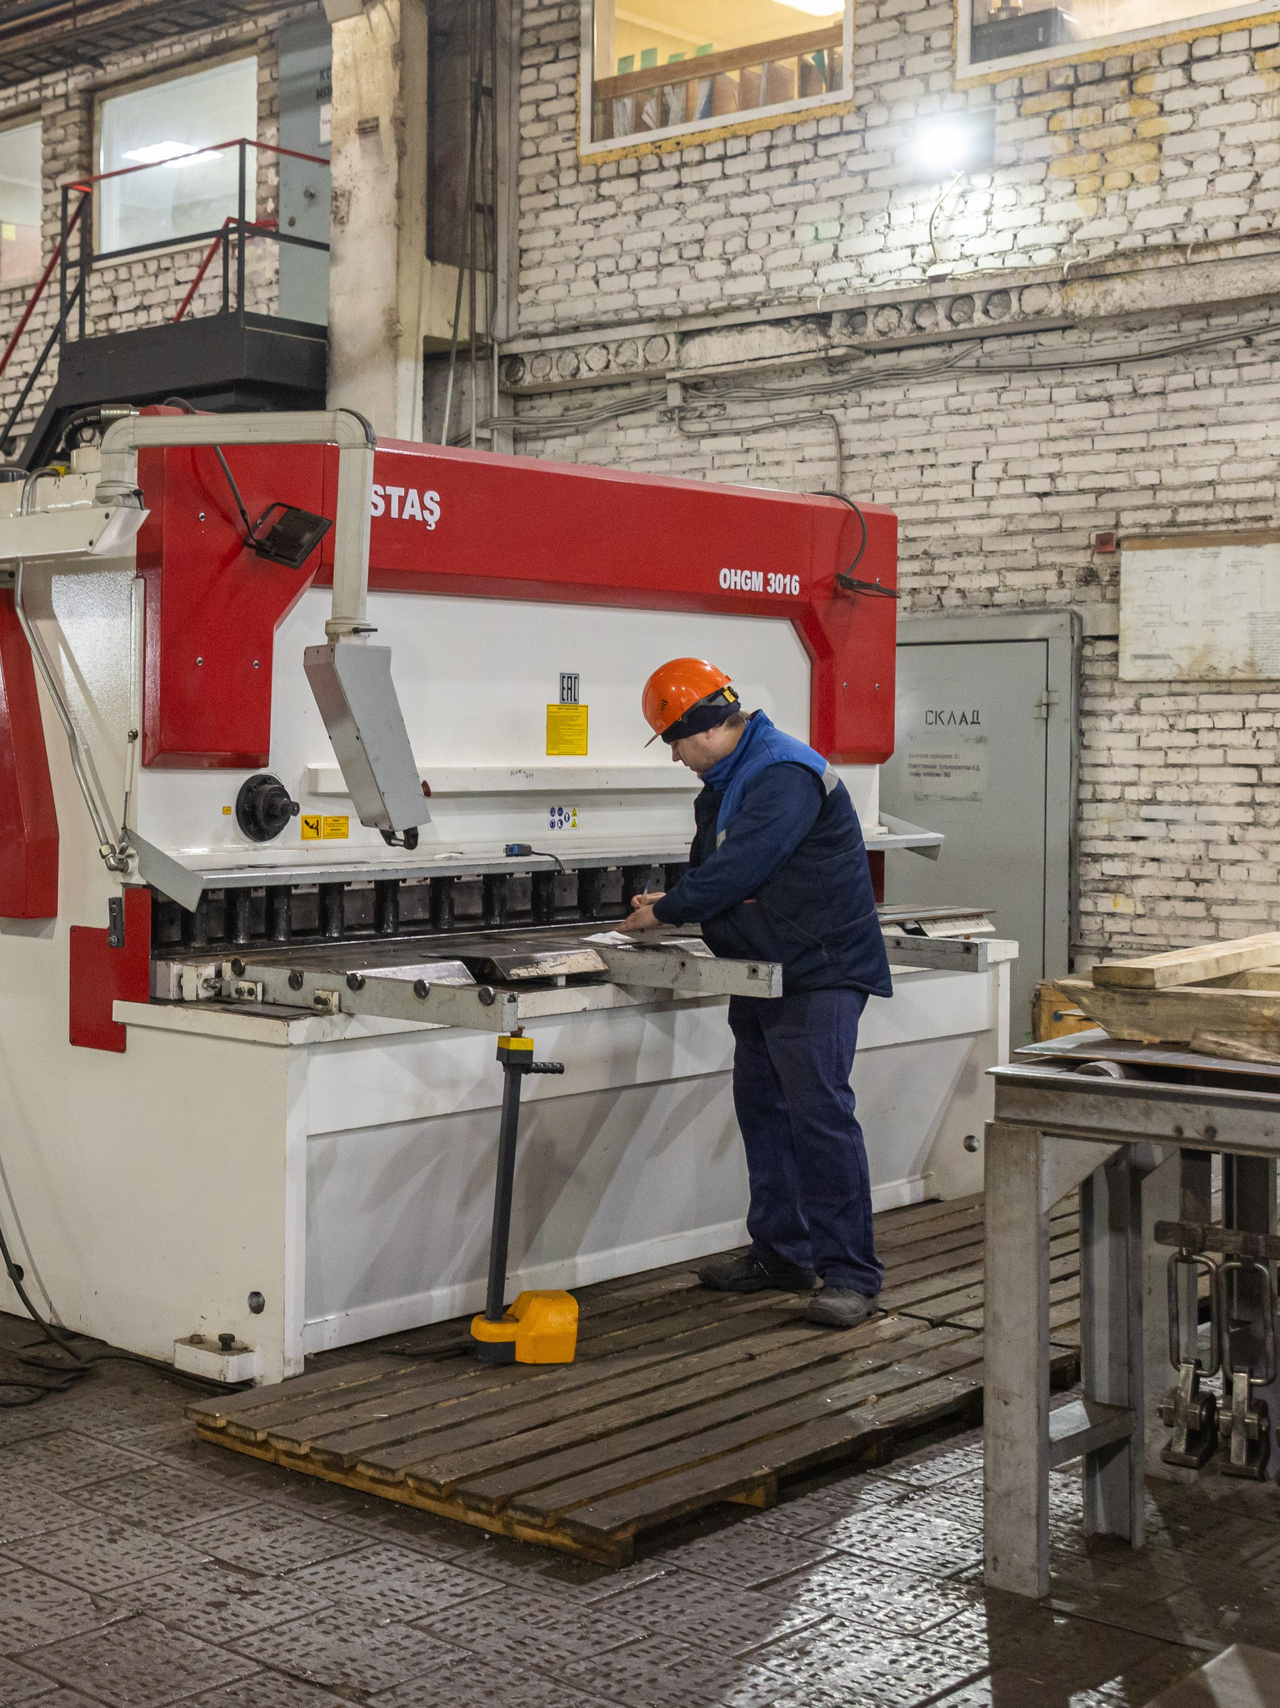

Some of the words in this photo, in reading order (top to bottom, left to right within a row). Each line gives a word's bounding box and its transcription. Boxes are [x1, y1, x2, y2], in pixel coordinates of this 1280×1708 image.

[371, 484, 441, 530] STAŞ
[719, 568, 764, 592] OHGM
[766, 572, 800, 596] 3016
[561, 675, 578, 702] EAC
[925, 710, 981, 725] СКЛАД
